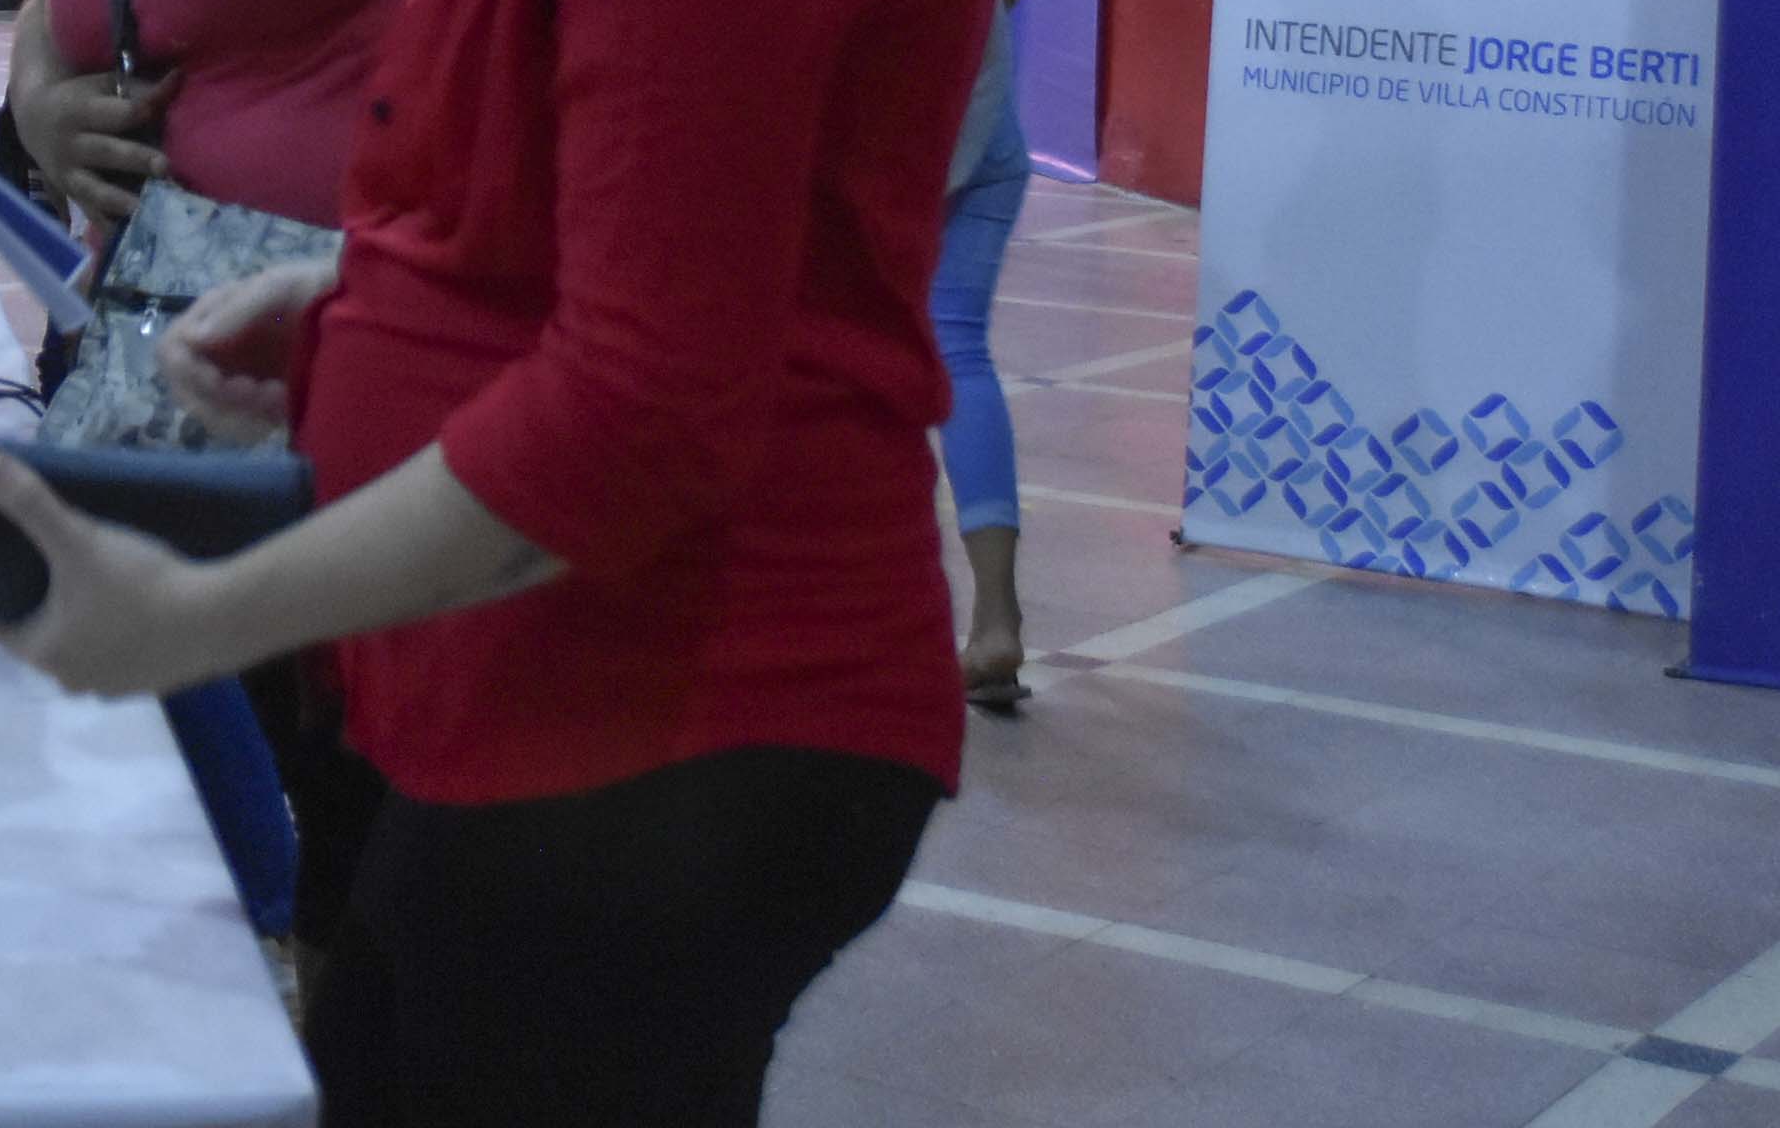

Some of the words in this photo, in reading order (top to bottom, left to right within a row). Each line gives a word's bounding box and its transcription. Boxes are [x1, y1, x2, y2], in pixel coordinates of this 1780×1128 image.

[1244, 18, 1458, 67] INTENDENTE
[1462, 36, 1579, 77] JORGE
[1589, 45, 1700, 87] BERTI
[1242, 65, 1371, 99] MUNICIPIO
[1377, 77, 1410, 102] DE
[1418, 80, 1490, 109] VILLA
[1498, 87, 1697, 129] CONSTITUCIÓN
